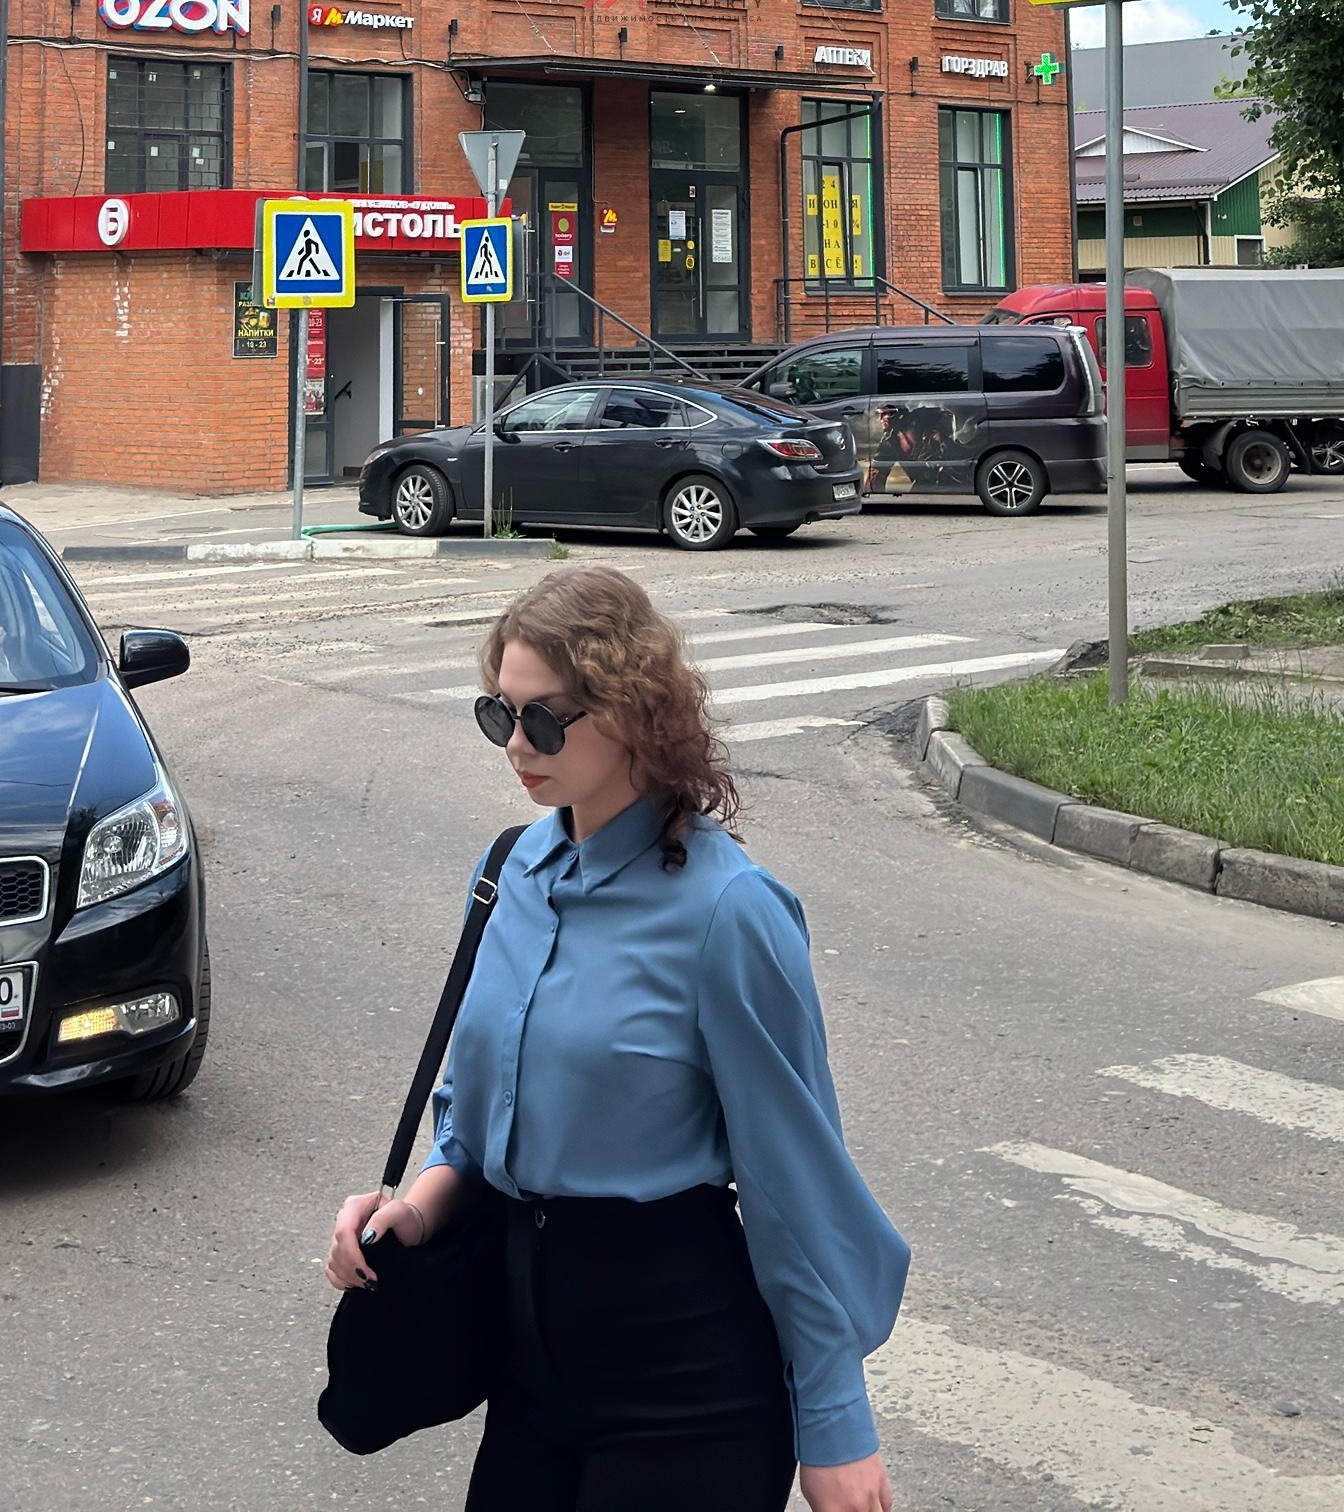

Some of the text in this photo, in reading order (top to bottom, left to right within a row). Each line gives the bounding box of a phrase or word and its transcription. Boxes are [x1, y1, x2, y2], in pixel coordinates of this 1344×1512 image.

[344, 9, 415, 34] Маркет
[814, 45, 872, 67] АПТЕКИ
[941, 55, 1009, 78] ГОРЗДРАВ
[238, 329, 274, 337] НАПИТКИ
